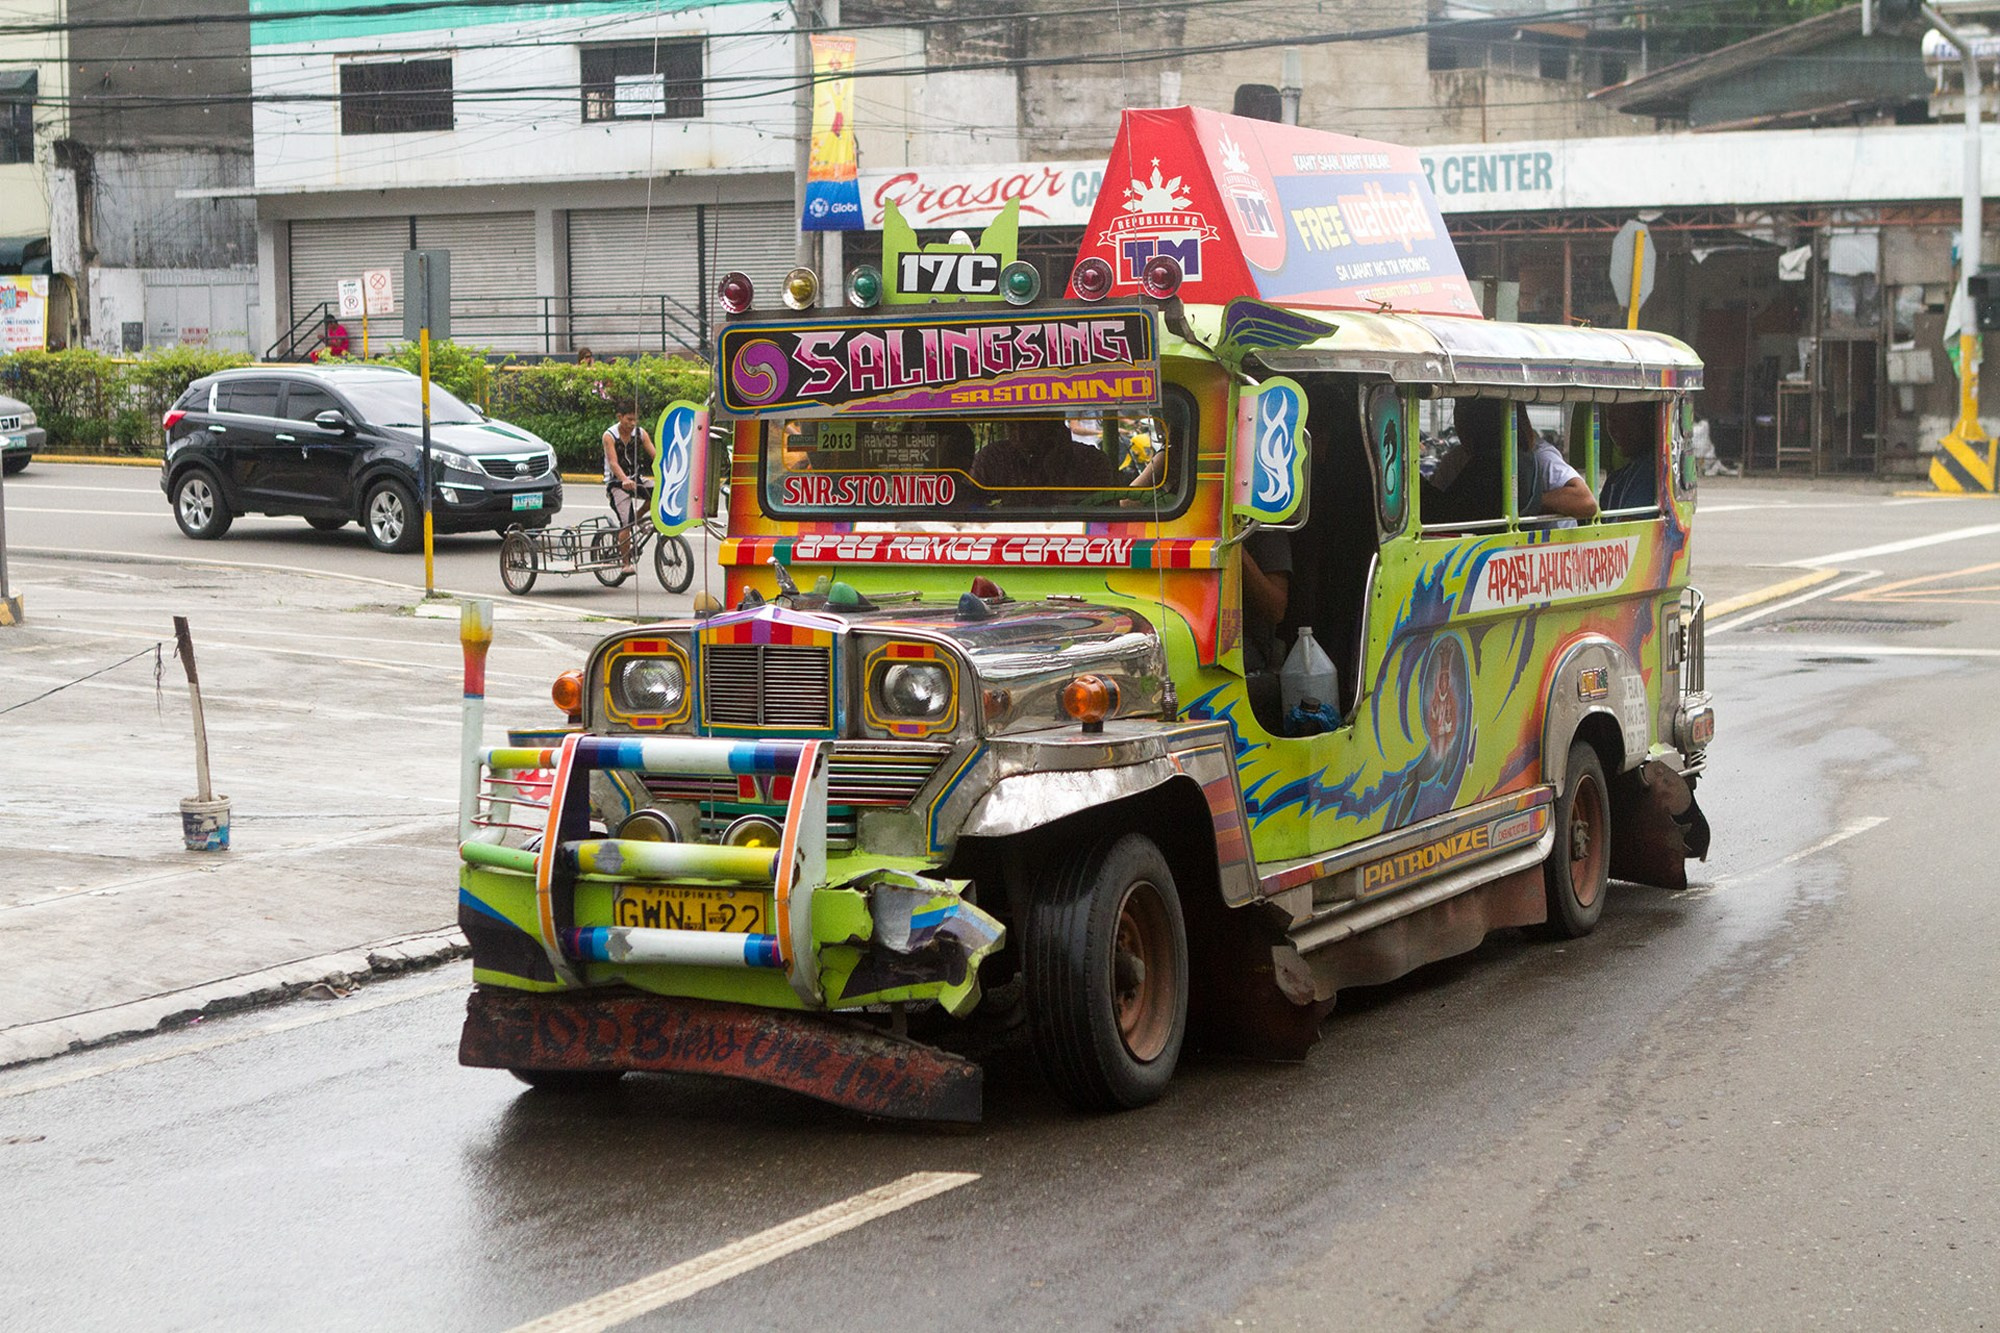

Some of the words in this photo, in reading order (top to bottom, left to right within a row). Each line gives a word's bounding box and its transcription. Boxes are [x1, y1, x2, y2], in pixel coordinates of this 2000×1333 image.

[871, 166, 1066, 225] Grasar
[1442, 151, 1554, 195] CENTER
[1117, 213, 1179, 231] REPUBLIKA
[1184, 214, 1198, 226] NG
[1236, 197, 1275, 232] TM
[1290, 205, 1351, 252] FREE
[1340, 182, 1435, 251] wattpad
[901, 255, 998, 293] 17C
[1123, 238, 1199, 278] TM
[1335, 264, 1350, 281] SA
[1348, 262, 1373, 279] LAHAT
[1373, 261, 1387, 276] NG
[1385, 259, 1400, 275] TM
[1398, 256, 1431, 273] PROMOS
[791, 319, 1134, 397] SALINGSING
[822, 433, 853, 449] 2013
[1587, 540, 1629, 591] CARBON
[1364, 826, 1488, 889] PATRONIZE
[658, 889, 722, 900] PILIPINAS
